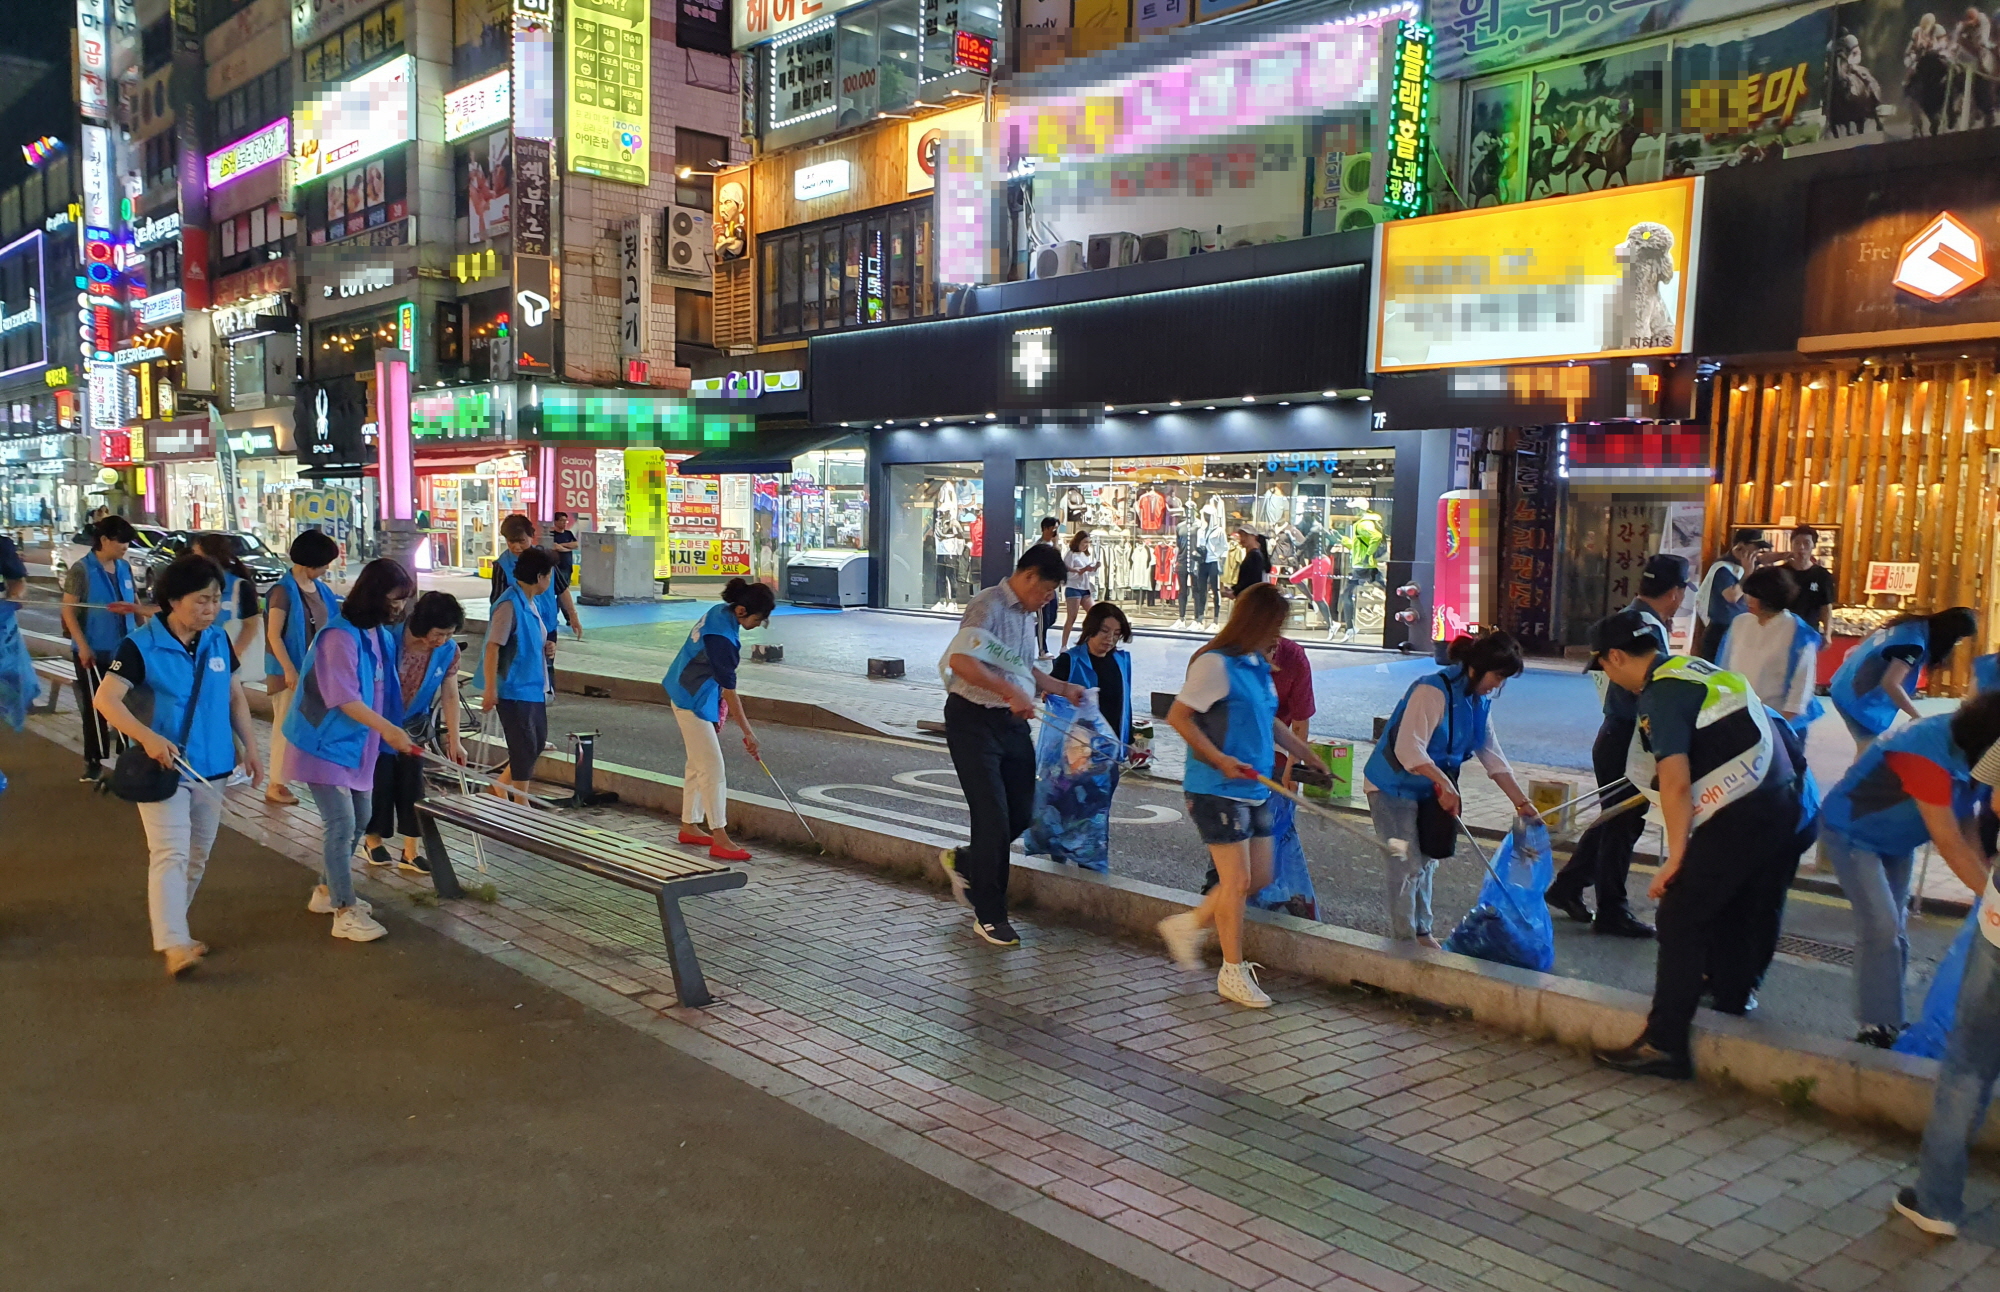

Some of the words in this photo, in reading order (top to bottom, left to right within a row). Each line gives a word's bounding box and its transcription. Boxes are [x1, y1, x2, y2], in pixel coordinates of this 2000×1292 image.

[576, 21, 596, 33] 노래방
[1403, 23, 1426, 41] 2F
[604, 85, 615, 94] VR
[1373, 411, 1387, 429] 7F
[561, 456, 593, 468] Galaxy
[560, 468, 594, 490] S10
[565, 490, 590, 508] 5G
[679, 540, 710, 549] 스마트폰
[722, 540, 750, 555] 초특가
[722, 565, 739, 573] SALE
